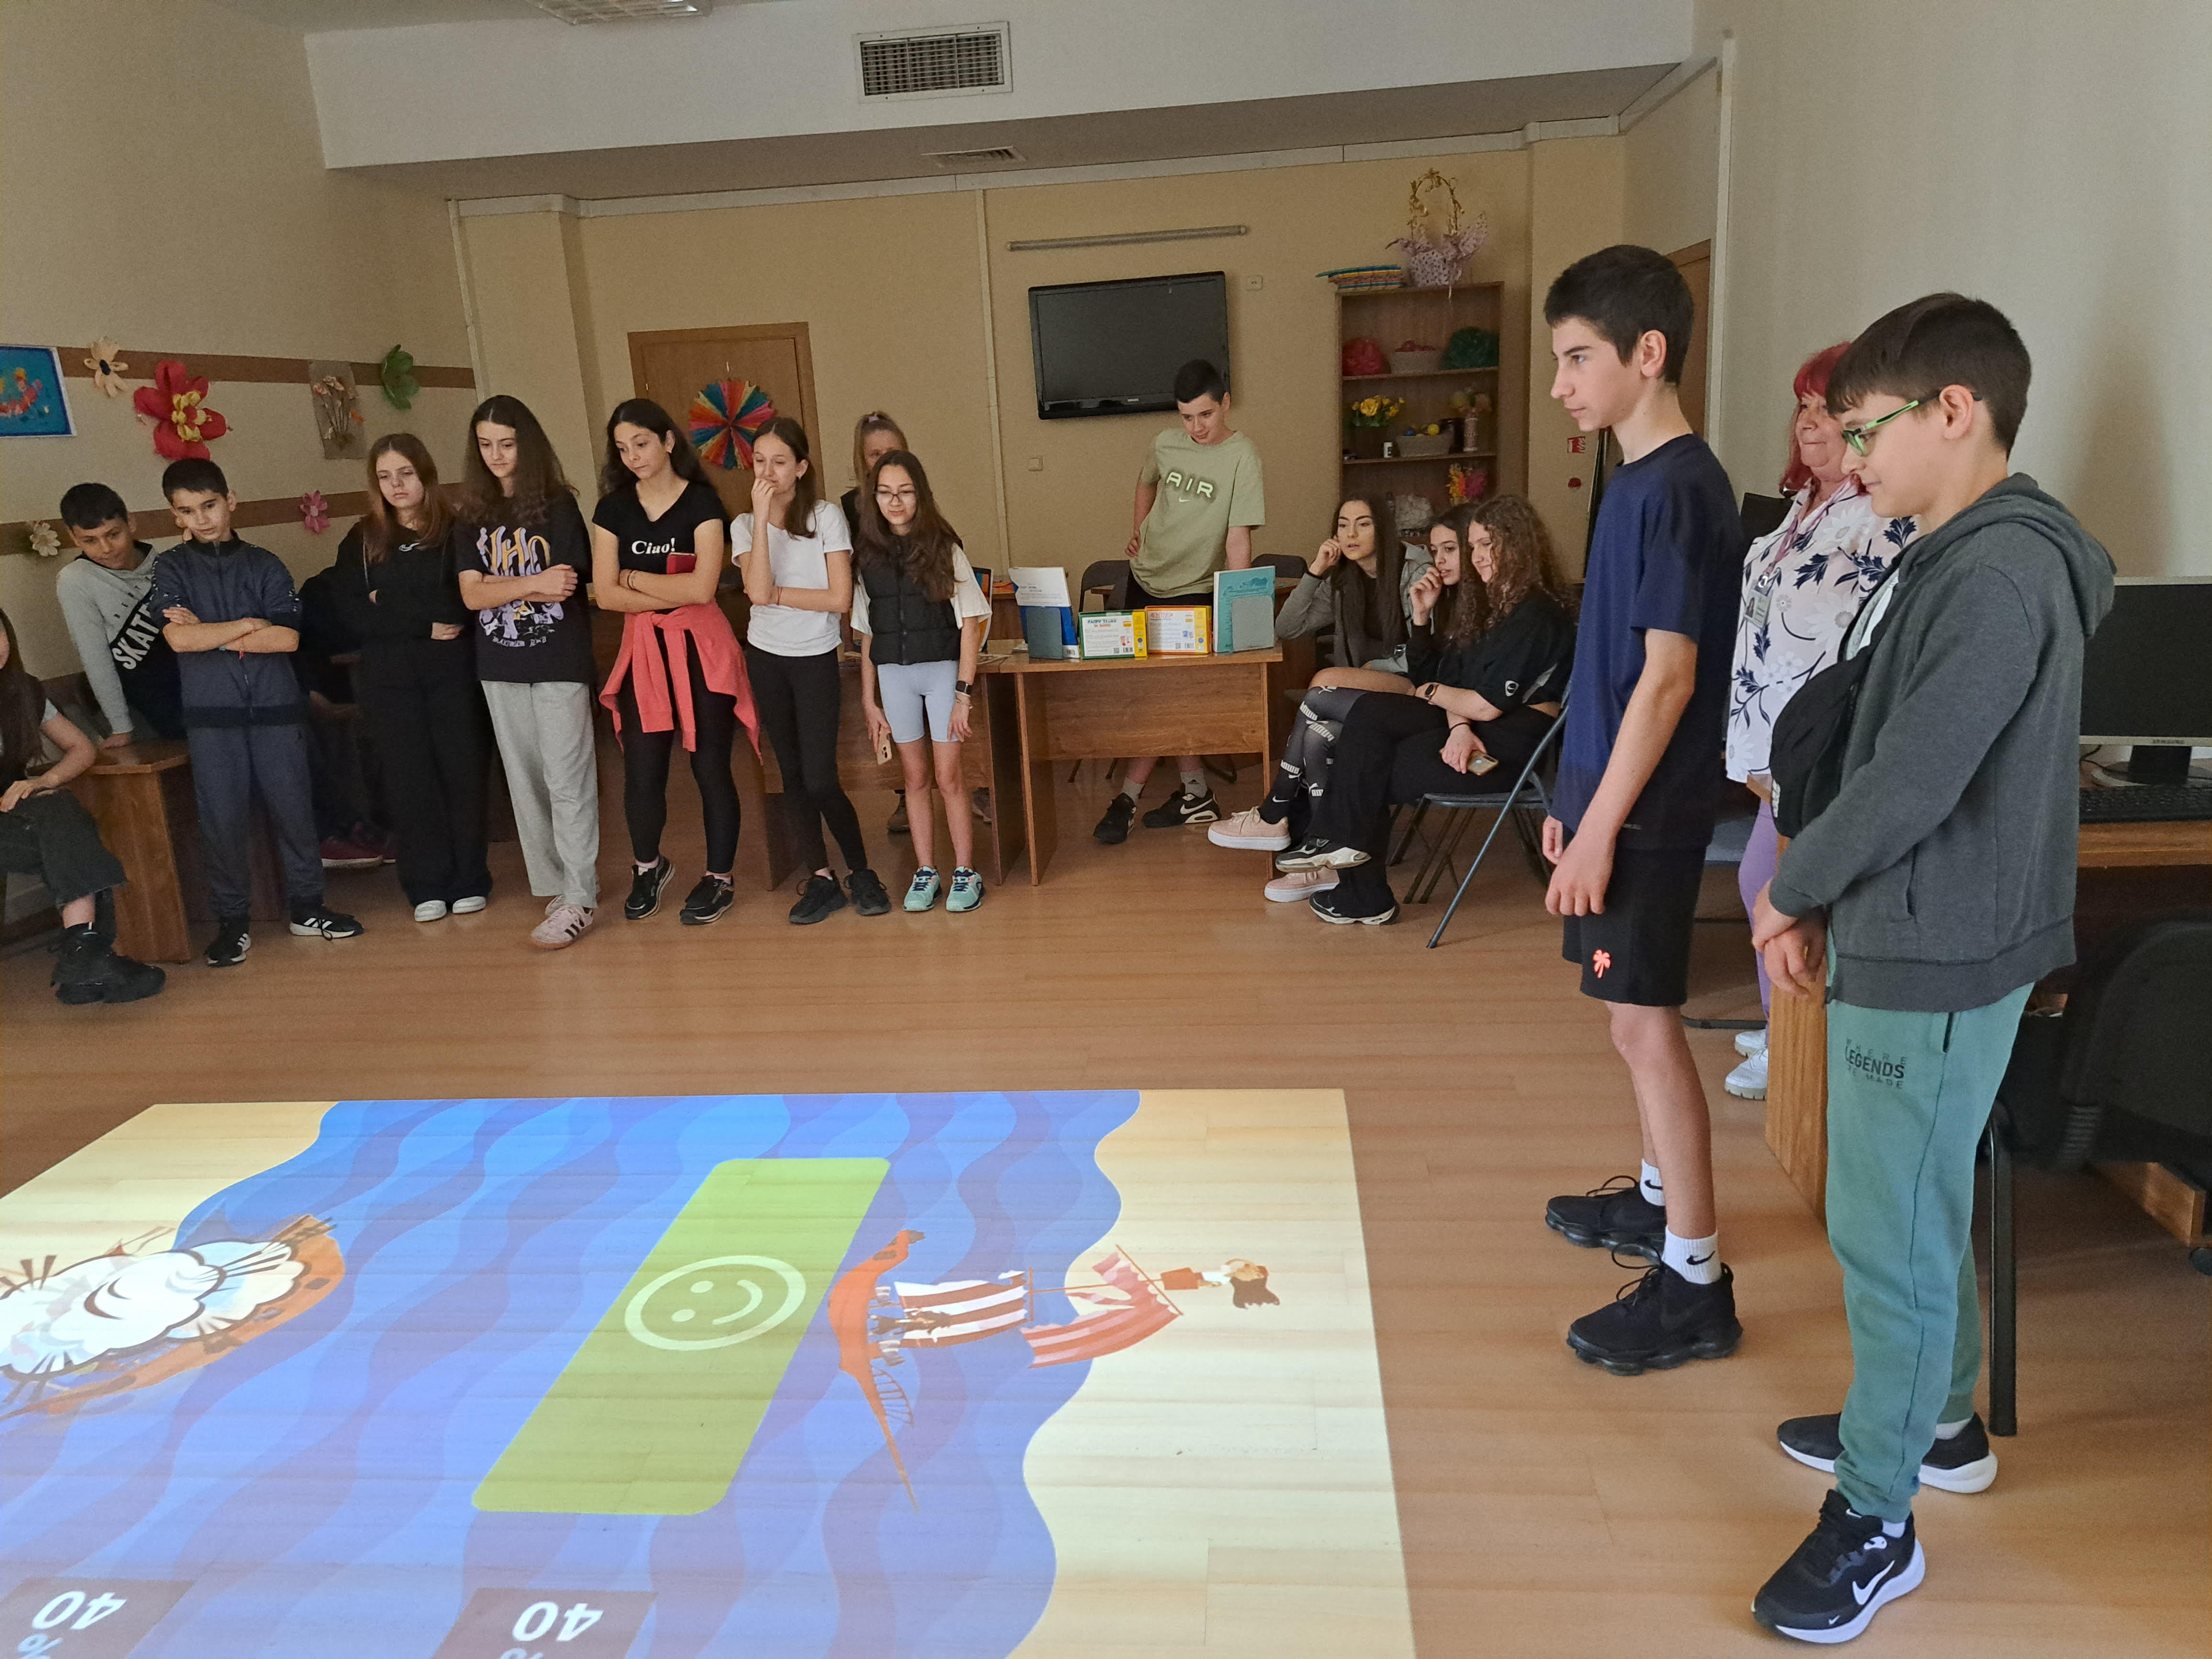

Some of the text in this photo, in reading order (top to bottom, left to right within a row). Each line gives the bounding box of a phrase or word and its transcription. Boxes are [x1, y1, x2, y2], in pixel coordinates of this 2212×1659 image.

[1166, 472, 1213, 498] AIR
[631, 537, 675, 554] Ciao!
[1845, 1045, 1905, 1079] LEGENDS
[32, 1591, 127, 1630] 40
[512, 1601, 604, 1642] 40
